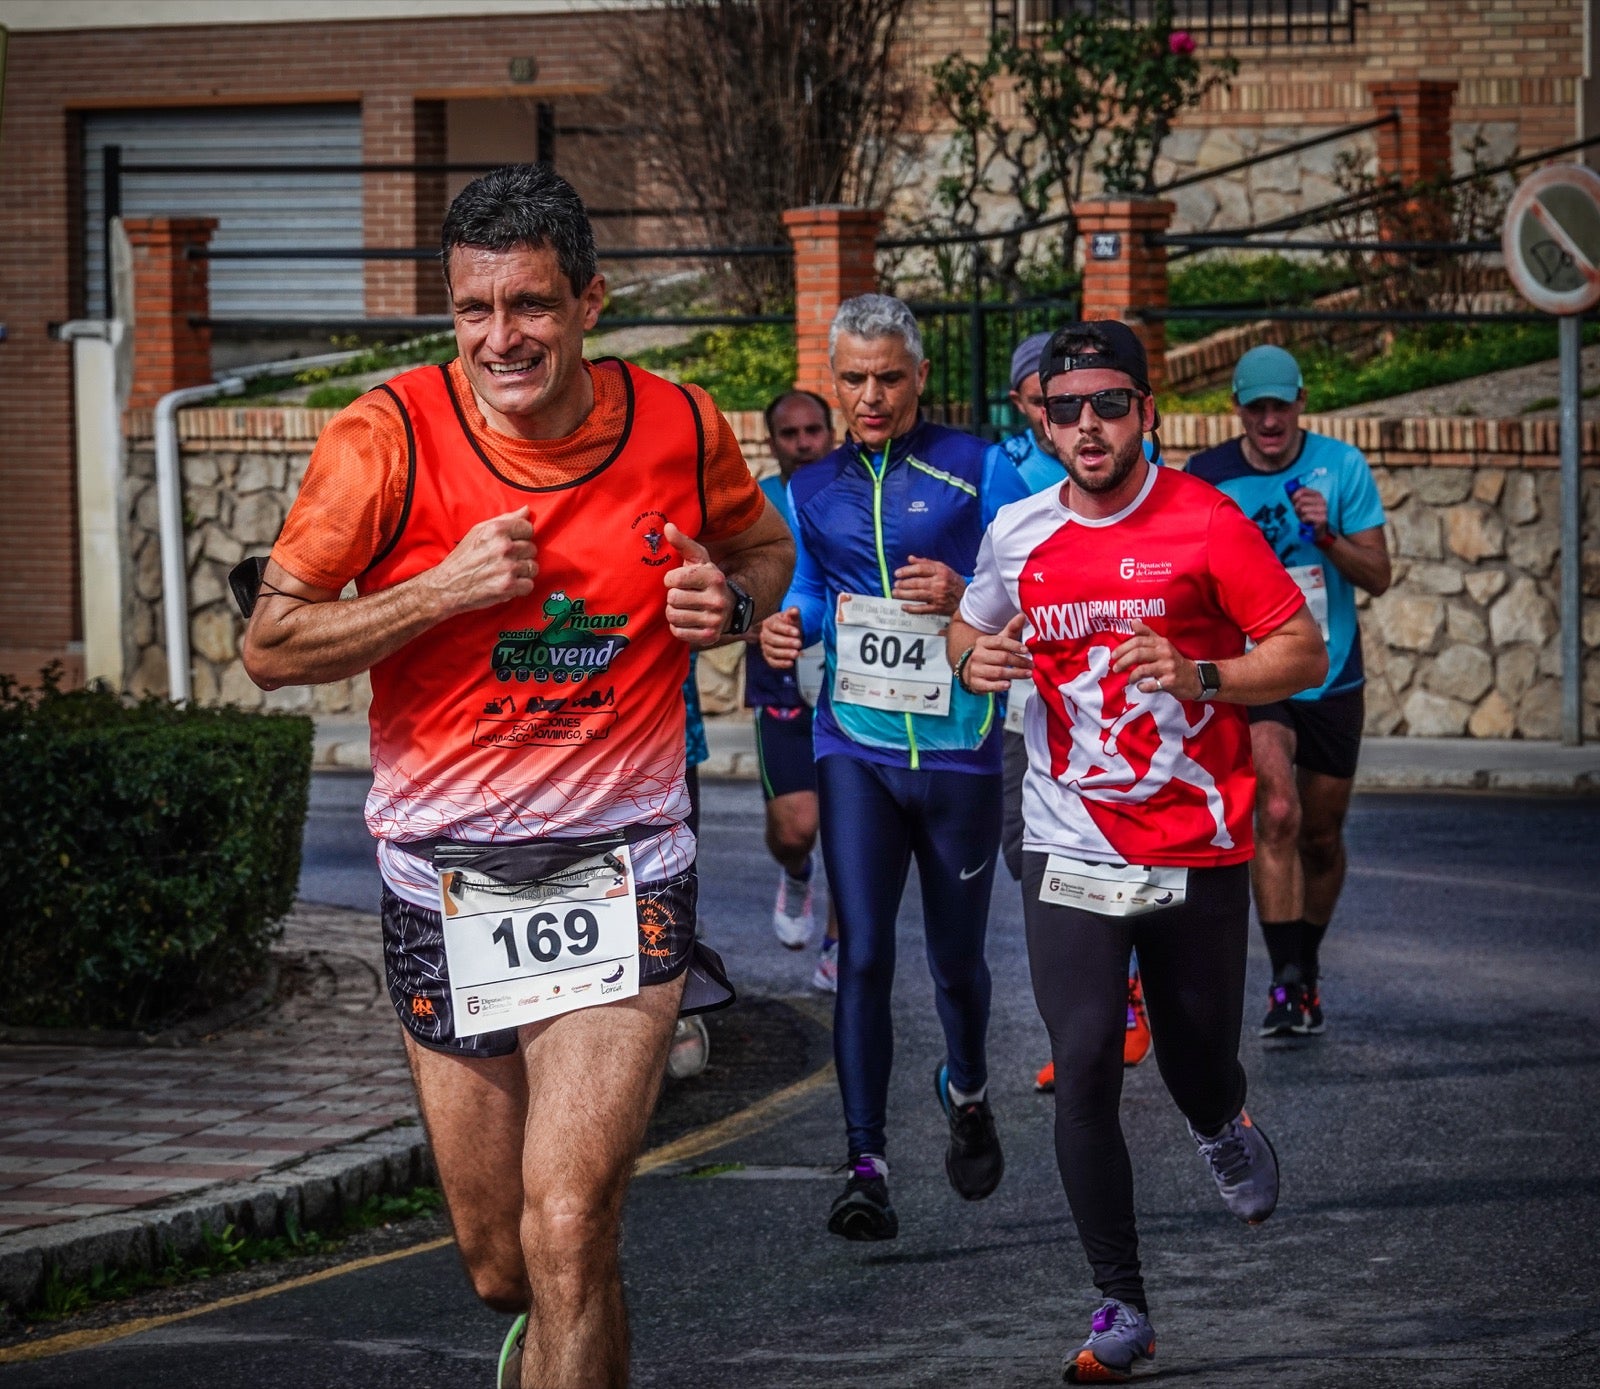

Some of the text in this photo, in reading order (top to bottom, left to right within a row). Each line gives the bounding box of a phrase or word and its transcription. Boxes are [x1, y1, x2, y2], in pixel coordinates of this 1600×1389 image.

[1136, 561, 1172, 570] Diputación
[1144, 569, 1172, 577] Granada
[569, 613, 629, 629] mano
[1030, 598, 1166, 641] XXXIII GRAN PREMIO
[1092, 618, 1111, 633] DE
[498, 629, 541, 640] ocasión
[860, 632, 926, 670] 604
[509, 886, 565, 904] UNIVERSO LORCA
[492, 908, 599, 969] 169
[600, 983, 623, 995] Lorca
